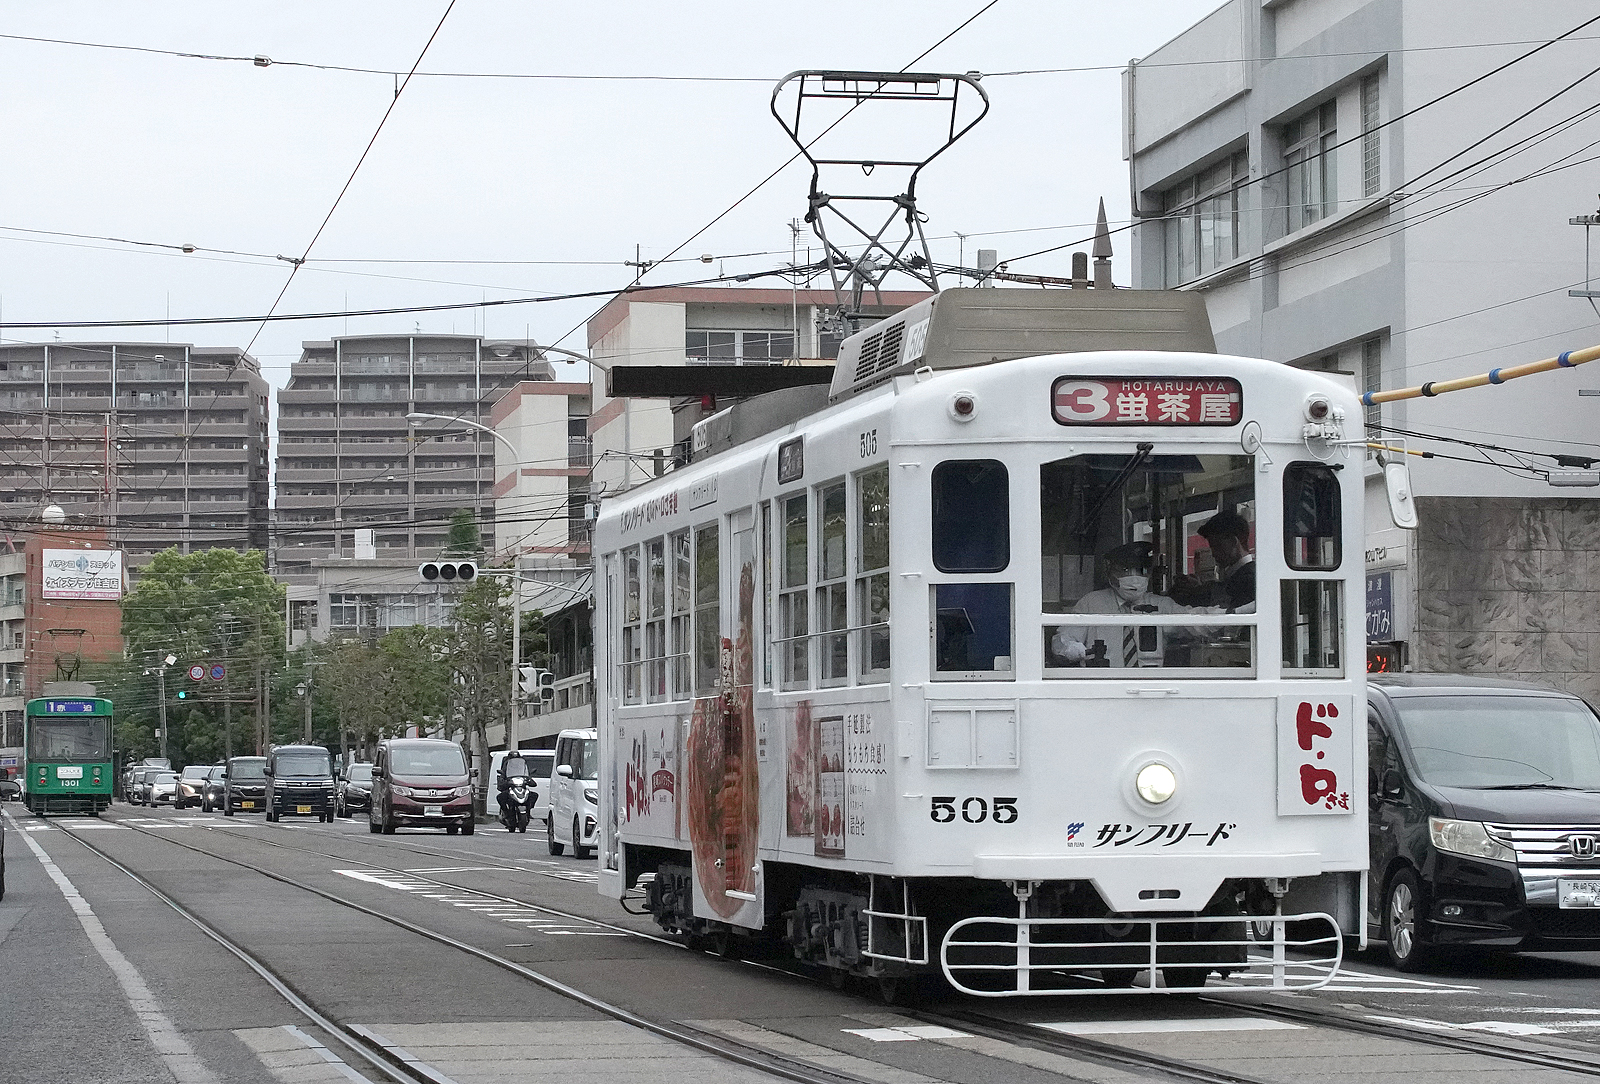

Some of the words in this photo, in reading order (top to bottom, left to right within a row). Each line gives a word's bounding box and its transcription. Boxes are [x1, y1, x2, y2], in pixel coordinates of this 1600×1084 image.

[1122, 382, 1226, 391] HOTARUJAYA
[1055, 381, 1111, 421] 3
[1116, 392, 1232, 422] 蛍茶屋
[860, 429, 877, 459] 505
[192, 668, 203, 677] 50
[49, 701, 54, 712] 1
[930, 796, 1018, 823] 505
[1092, 822, 1237, 848] サンフリード
